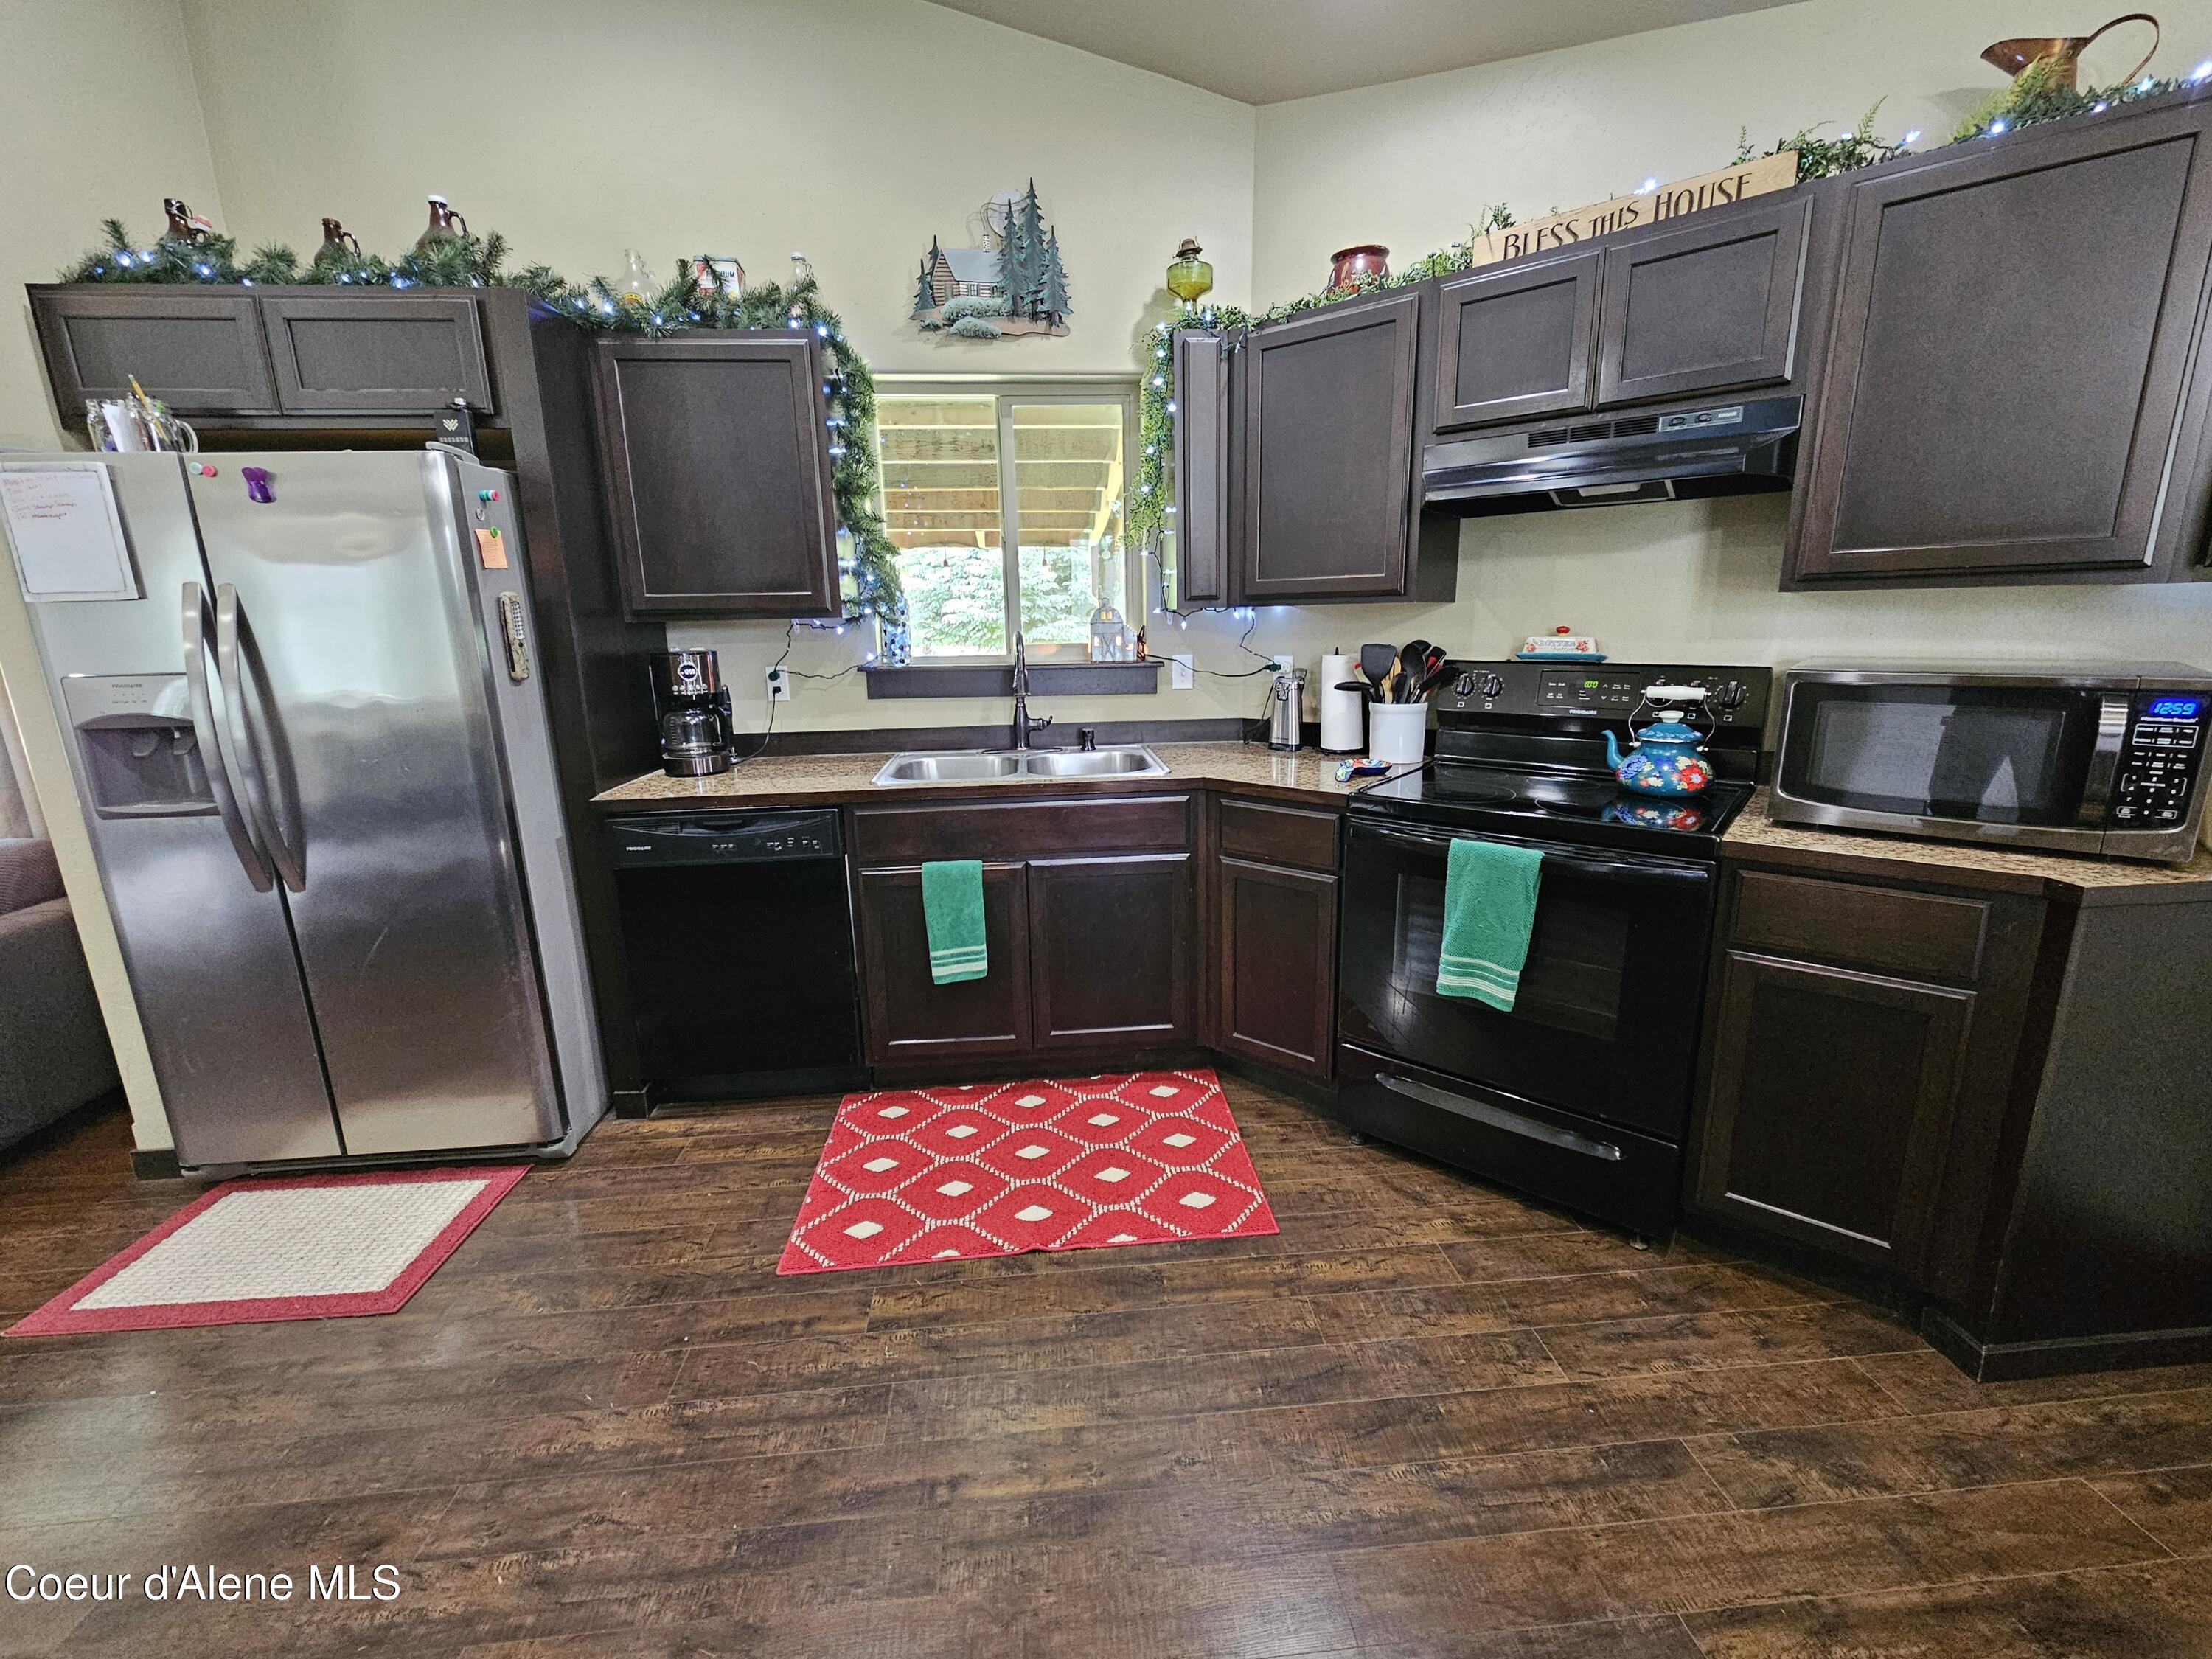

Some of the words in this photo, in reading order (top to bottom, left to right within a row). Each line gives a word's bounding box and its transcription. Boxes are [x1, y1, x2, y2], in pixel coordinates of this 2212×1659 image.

[1503, 218, 1580, 260] BLESS
[1588, 199, 1640, 237] THIS
[1653, 172, 1753, 223] HOUSE
